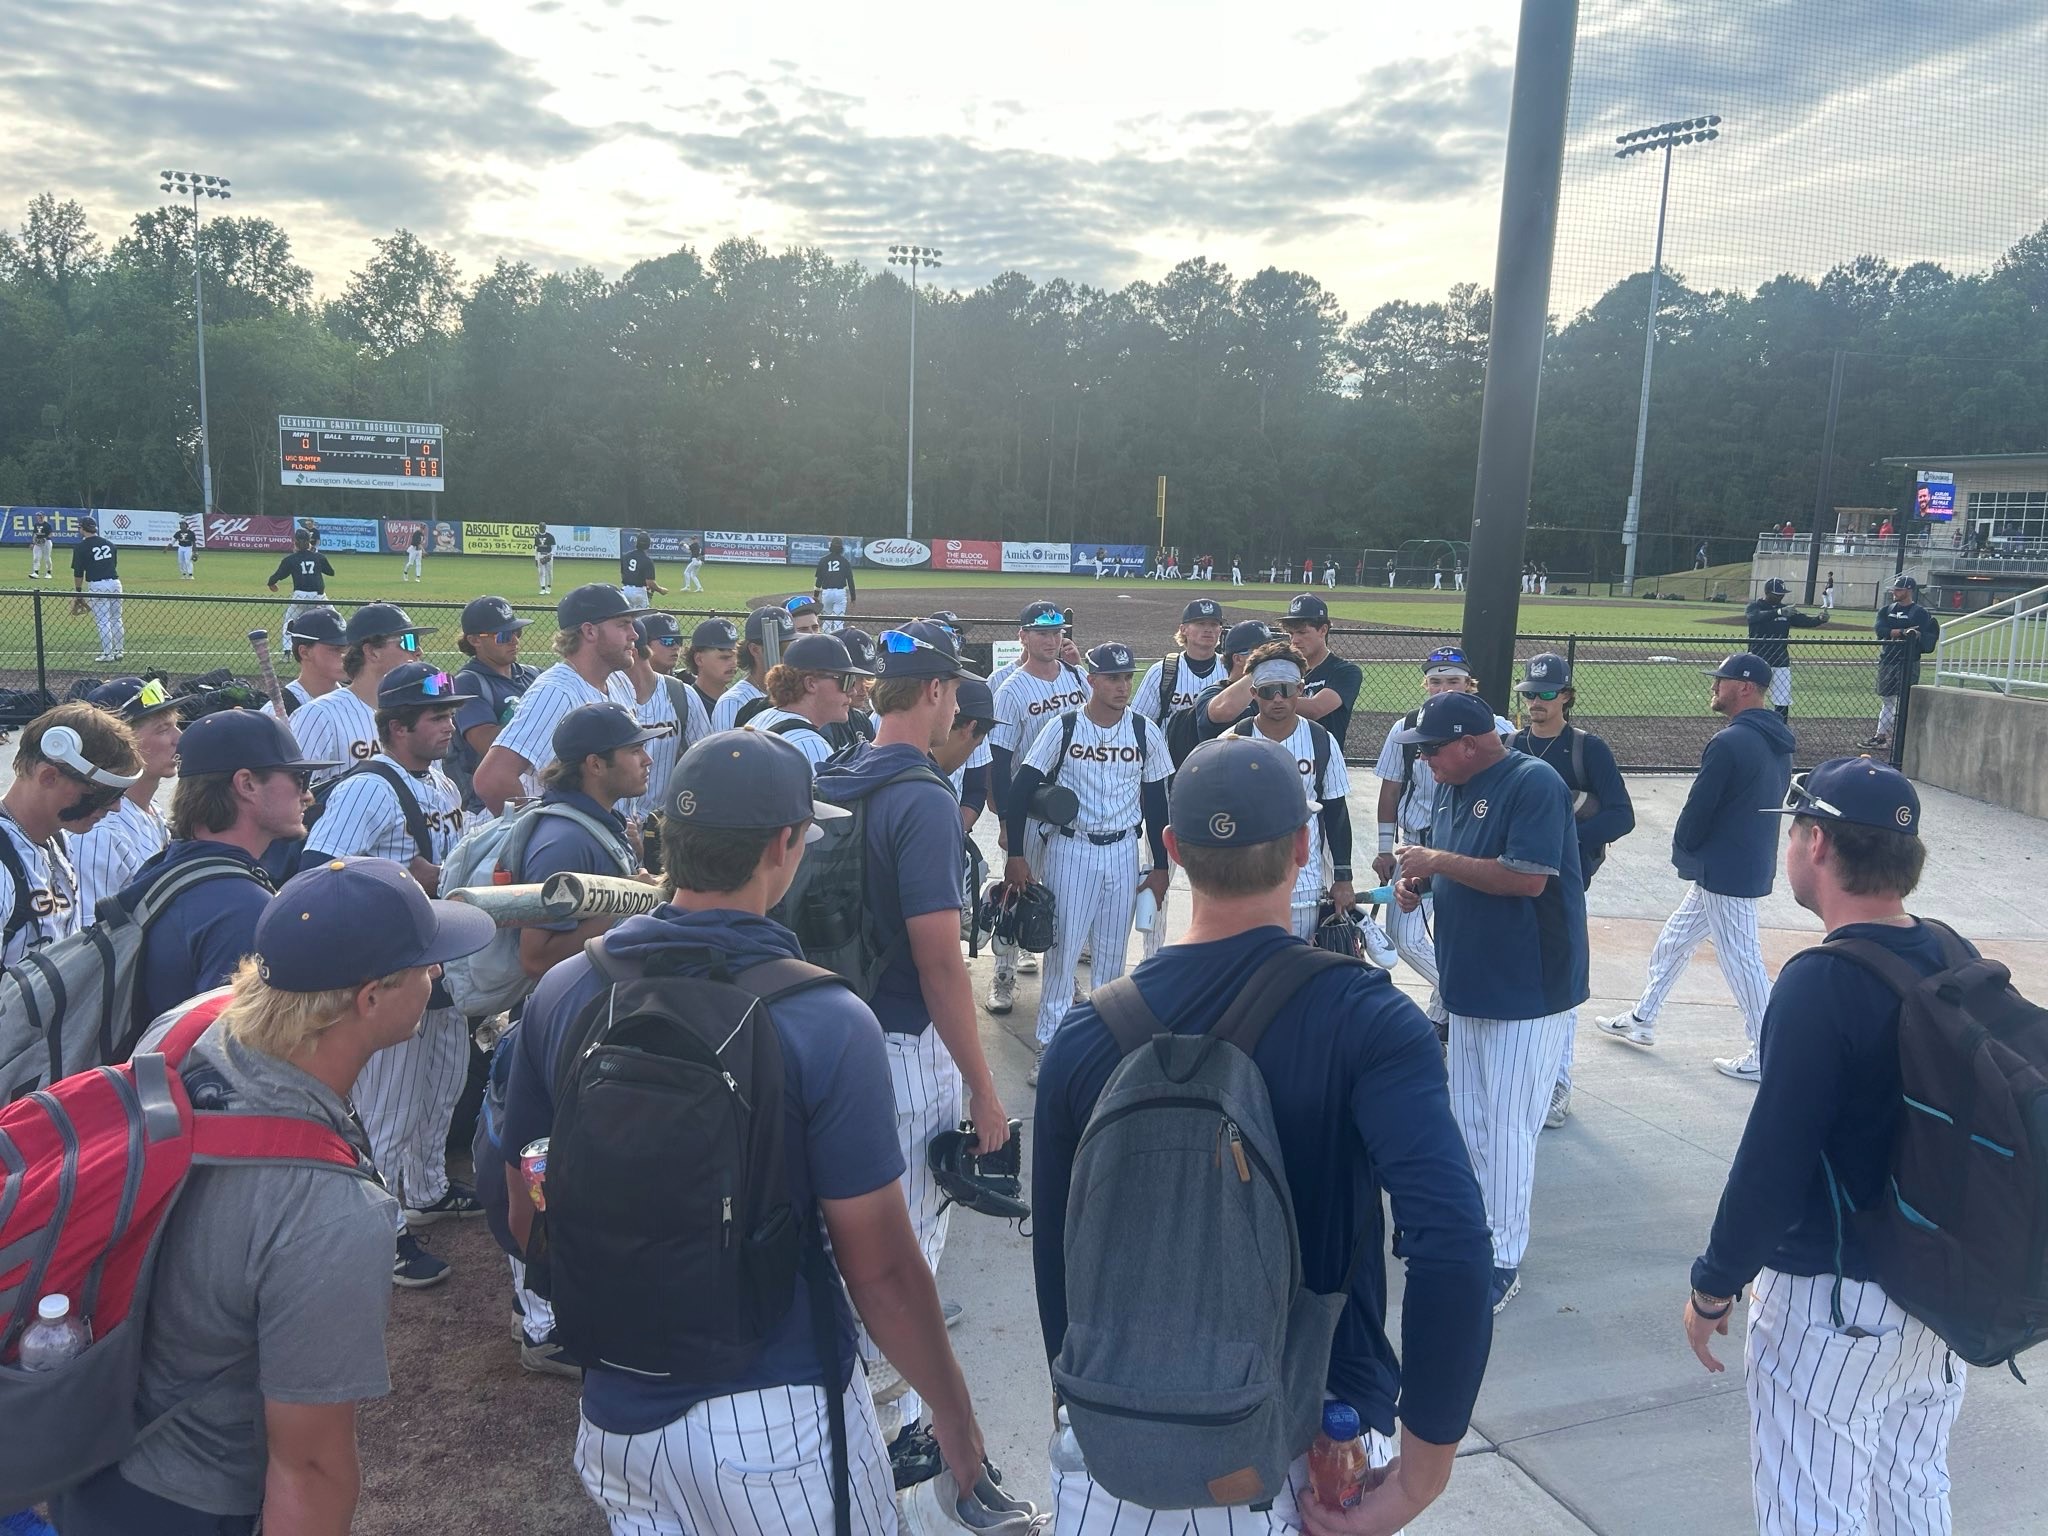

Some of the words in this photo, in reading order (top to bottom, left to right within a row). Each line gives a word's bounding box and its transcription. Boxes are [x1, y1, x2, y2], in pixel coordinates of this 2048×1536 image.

[282, 418, 326, 428] LEXINGTON
[330, 420, 360, 430] COUNTY
[364, 422, 403, 433] BASEBALL
[406, 424, 441, 434] STADIUM
[302, 438, 310, 449] 0
[423, 444, 430, 455] 0
[305, 476, 341, 485] Lexington
[342, 478, 370, 486] Medical
[371, 479, 394, 487] Center
[387, 522, 409, 534] We're
[465, 523, 510, 537] ABSOLUTE
[512, 525, 539, 538] GLASS
[706, 531, 742, 541] SAVE
[745, 533, 755, 542] A
[757, 534, 785, 542] LIFE
[468, 541, 492, 549] (803)
[556, 544, 607, 553] Mid-Carolina
[737, 543, 784, 551] PREVENTION
[873, 541, 923, 557] Shealy's
[92, 545, 112, 561] 22
[1004, 549, 1032, 560] Amick
[1043, 549, 1070, 561] Farms
[300, 560, 315, 575] 17
[628, 558, 637, 572] 9
[827, 560, 840, 572] 12
[946, 558, 989, 566] CONNECTION
[1103, 556, 1145, 565] MIELIN
[876, 657, 886, 673] G
[1028, 690, 1088, 716] GASTON
[676, 790, 697, 816] G
[1473, 799, 1488, 819] G
[1895, 805, 1912, 826] G
[1208, 812, 1236, 839] G
[583, 887, 654, 914] LOUISVILLE
